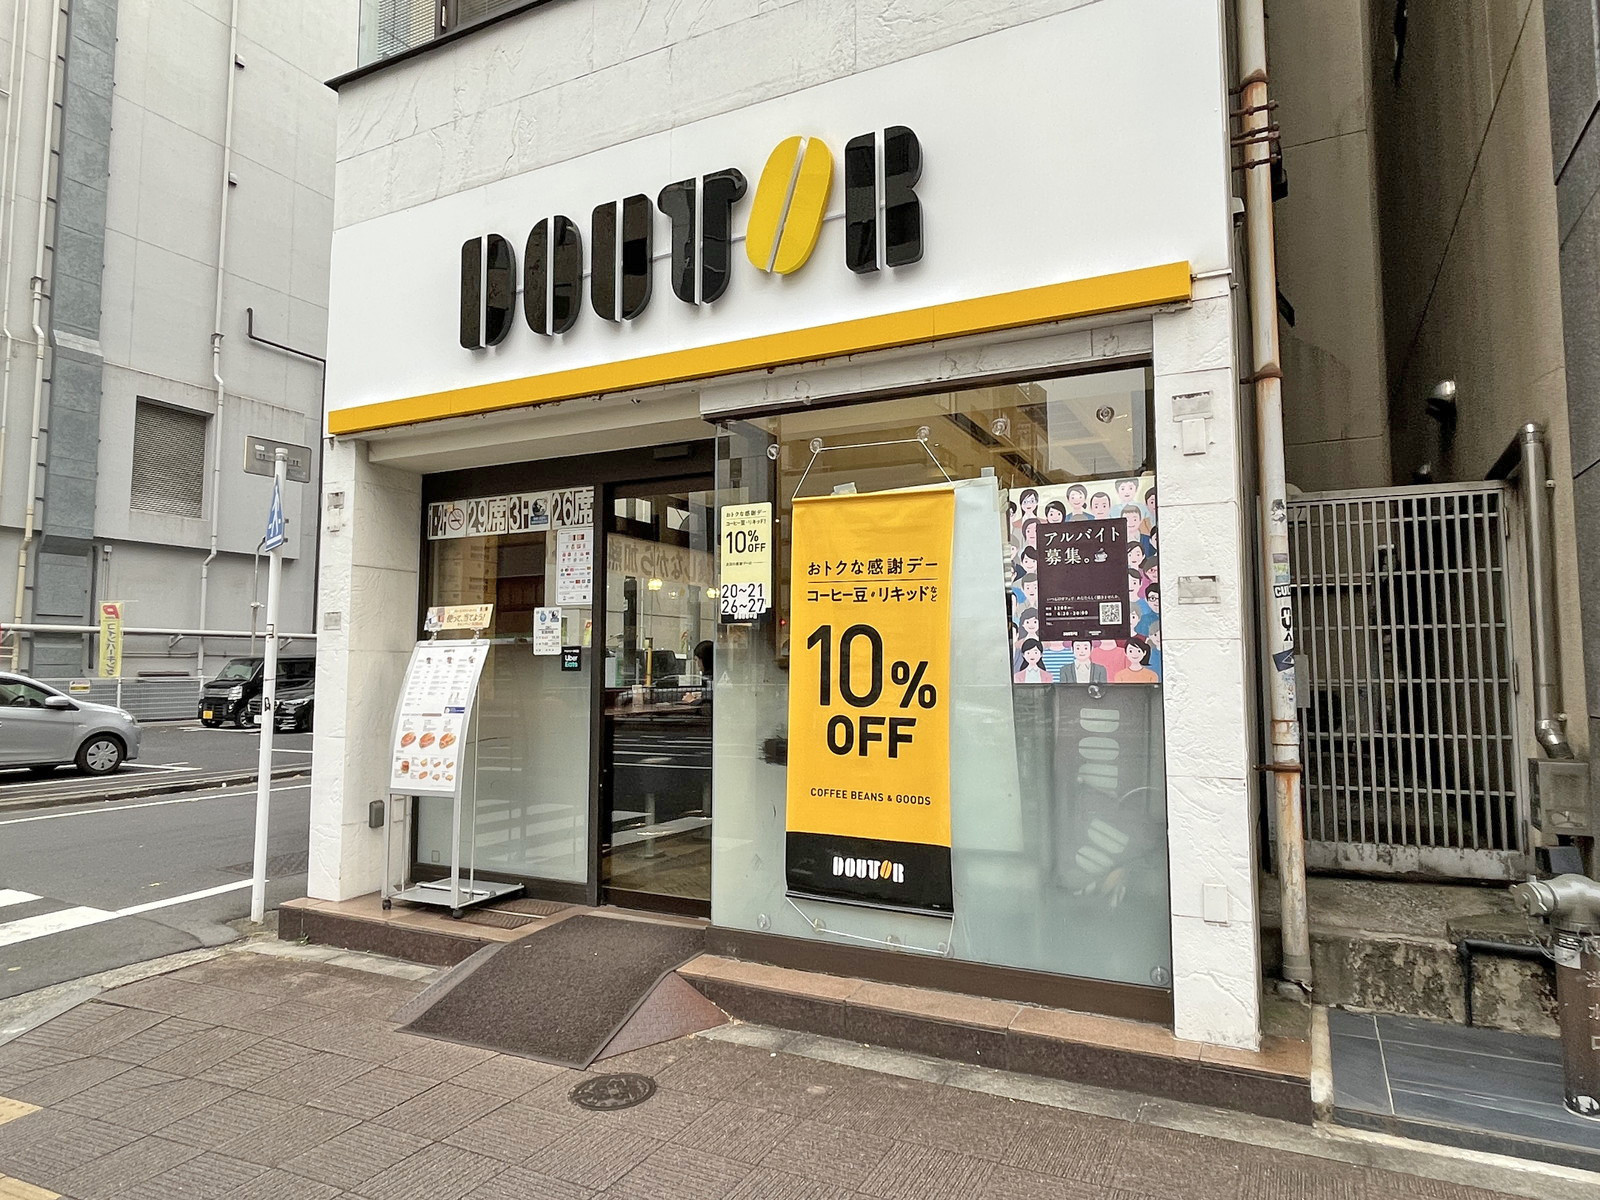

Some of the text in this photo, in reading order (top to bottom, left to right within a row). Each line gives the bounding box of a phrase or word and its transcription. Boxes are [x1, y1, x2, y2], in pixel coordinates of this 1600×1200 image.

[460, 125, 924, 351] DOUTOR
[1044, 526, 1121, 546] アルバイト
[747, 543, 766, 553] OFF
[1044, 547, 1090, 566] 募集。
[807, 556, 938, 576] おトクな感謝デー
[807, 624, 937, 709] 10%
[826, 714, 917, 759] OFF
[810, 787, 931, 806] COFFEE BEANS & GOODS
[832, 856, 905, 884] DOUTOR
